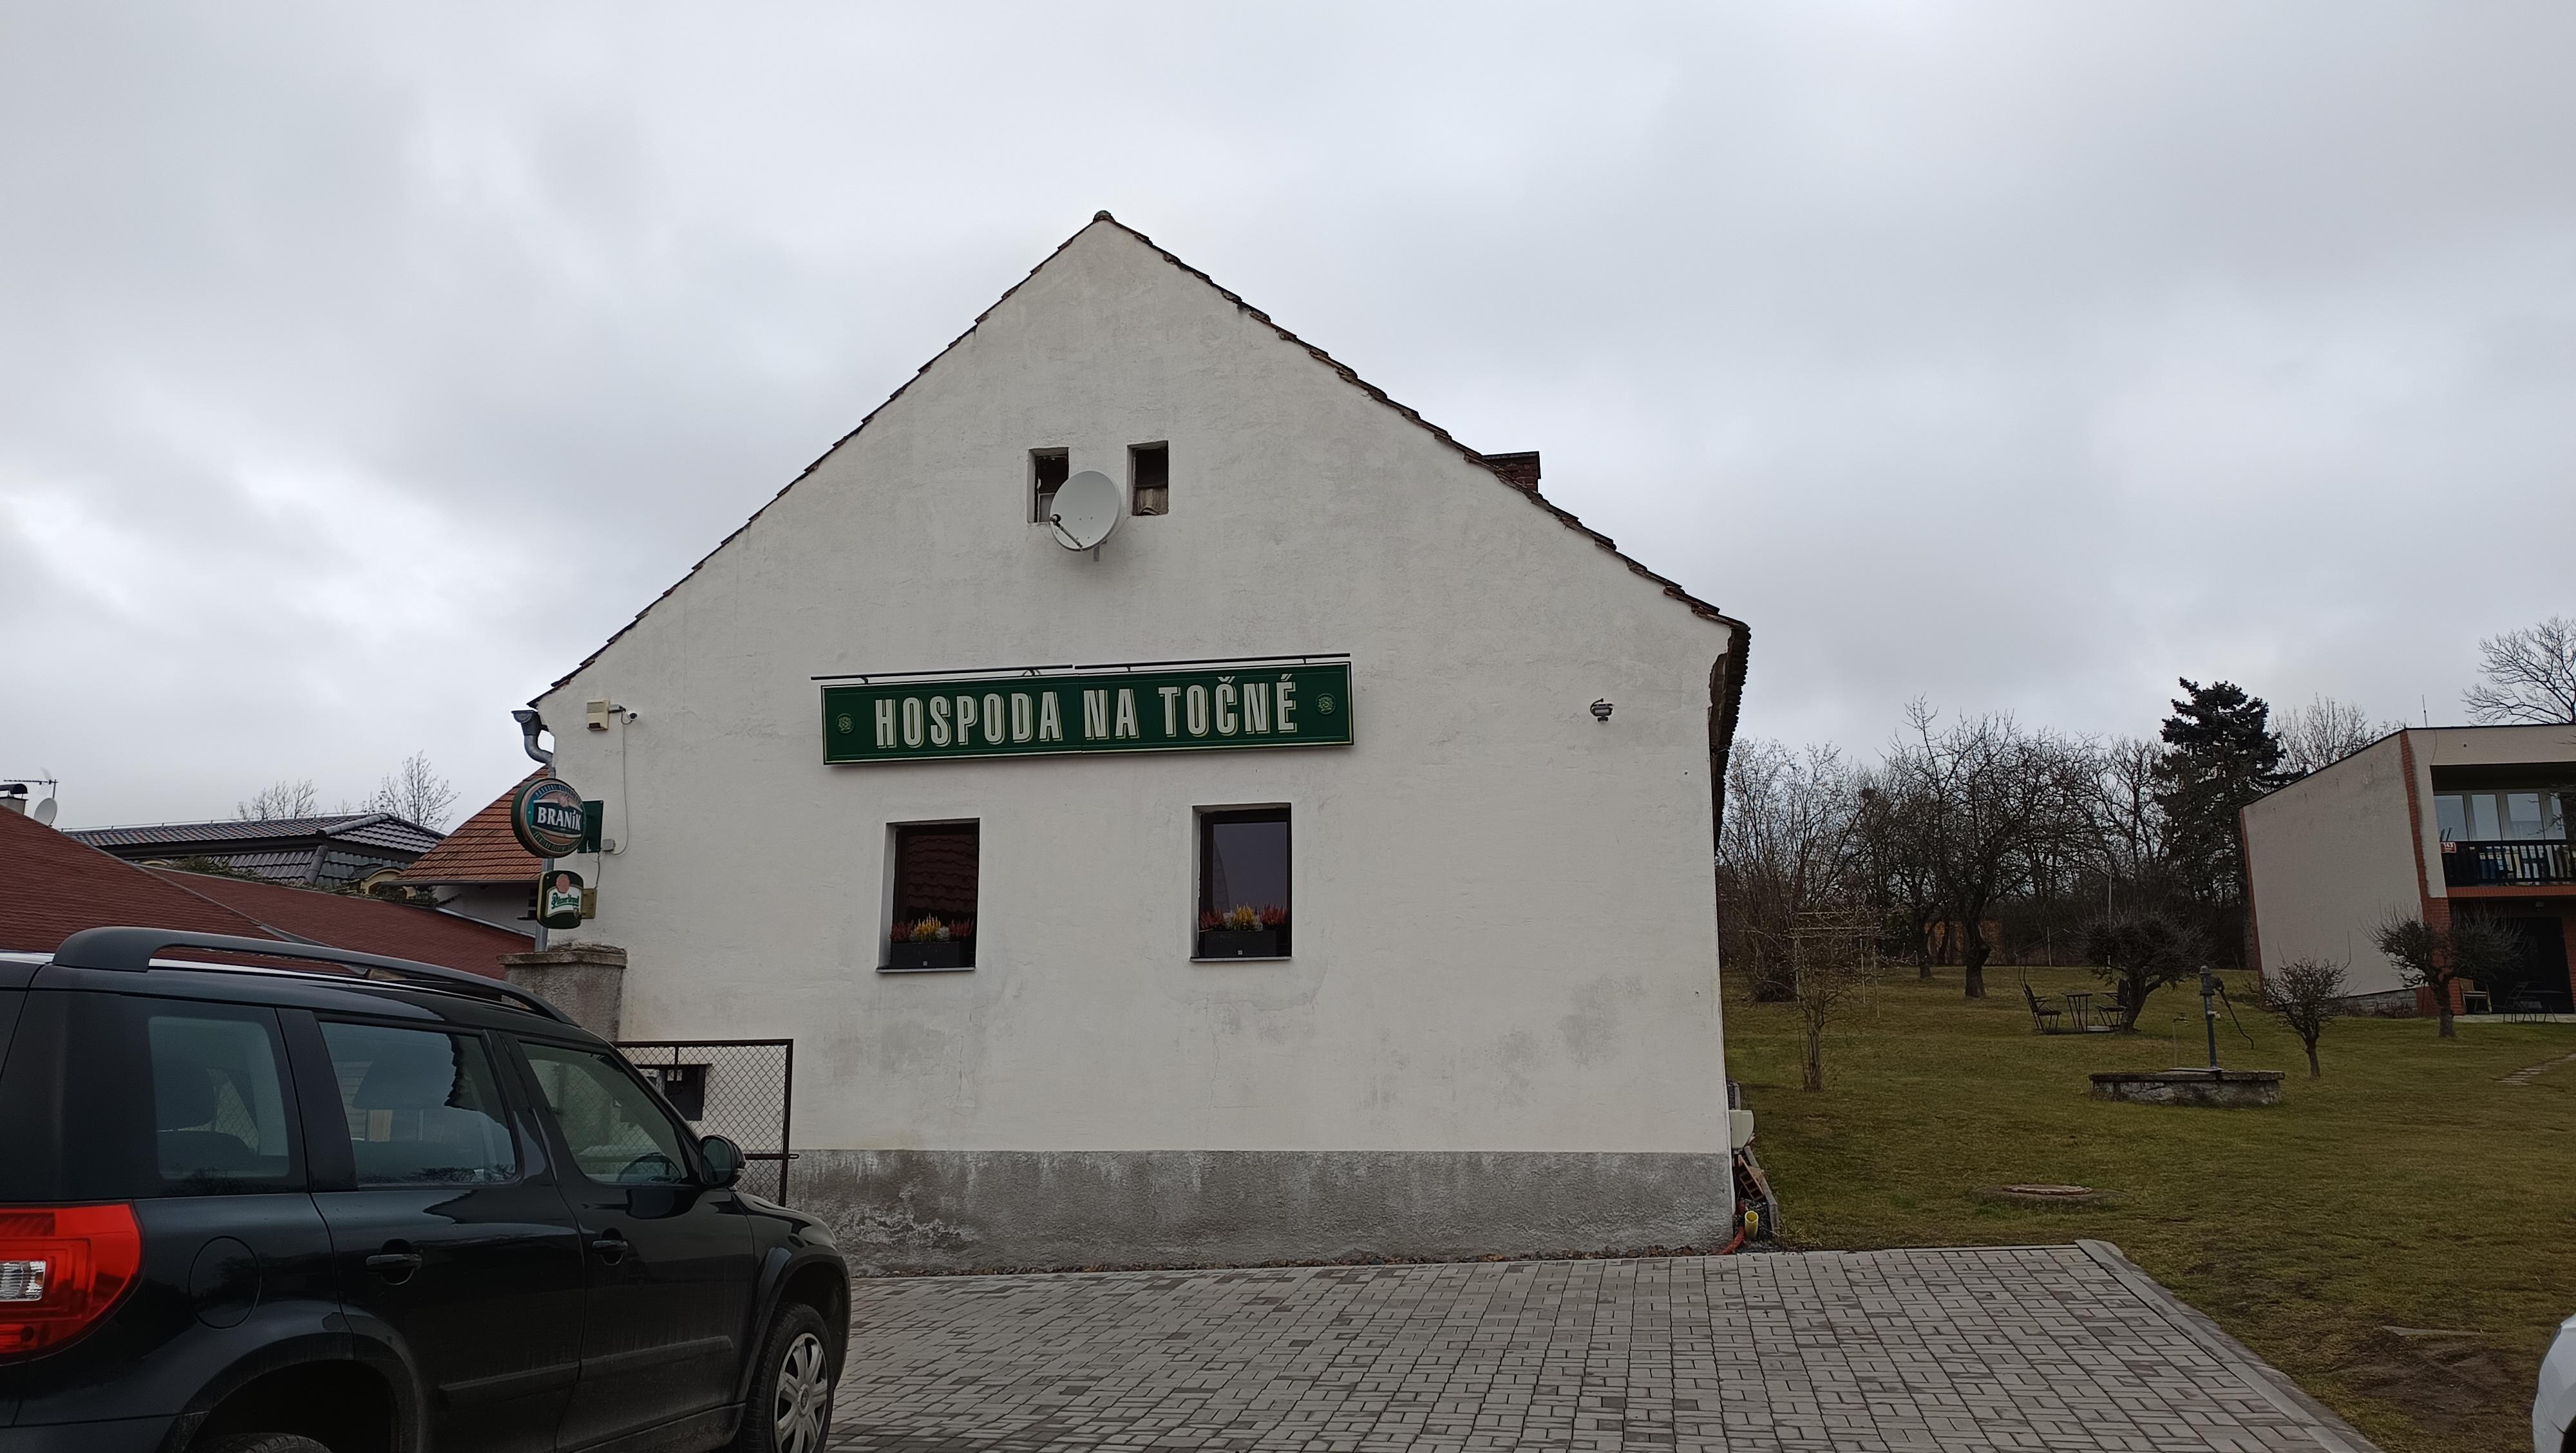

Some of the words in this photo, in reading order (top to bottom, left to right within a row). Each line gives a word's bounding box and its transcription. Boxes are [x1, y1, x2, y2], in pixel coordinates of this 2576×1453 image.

[875, 691, 1063, 748] HOSPODA
[1083, 688, 1139, 740] NA
[1159, 673, 1297, 737] TOČNÉ
[536, 806, 582, 831] BRANÍK
